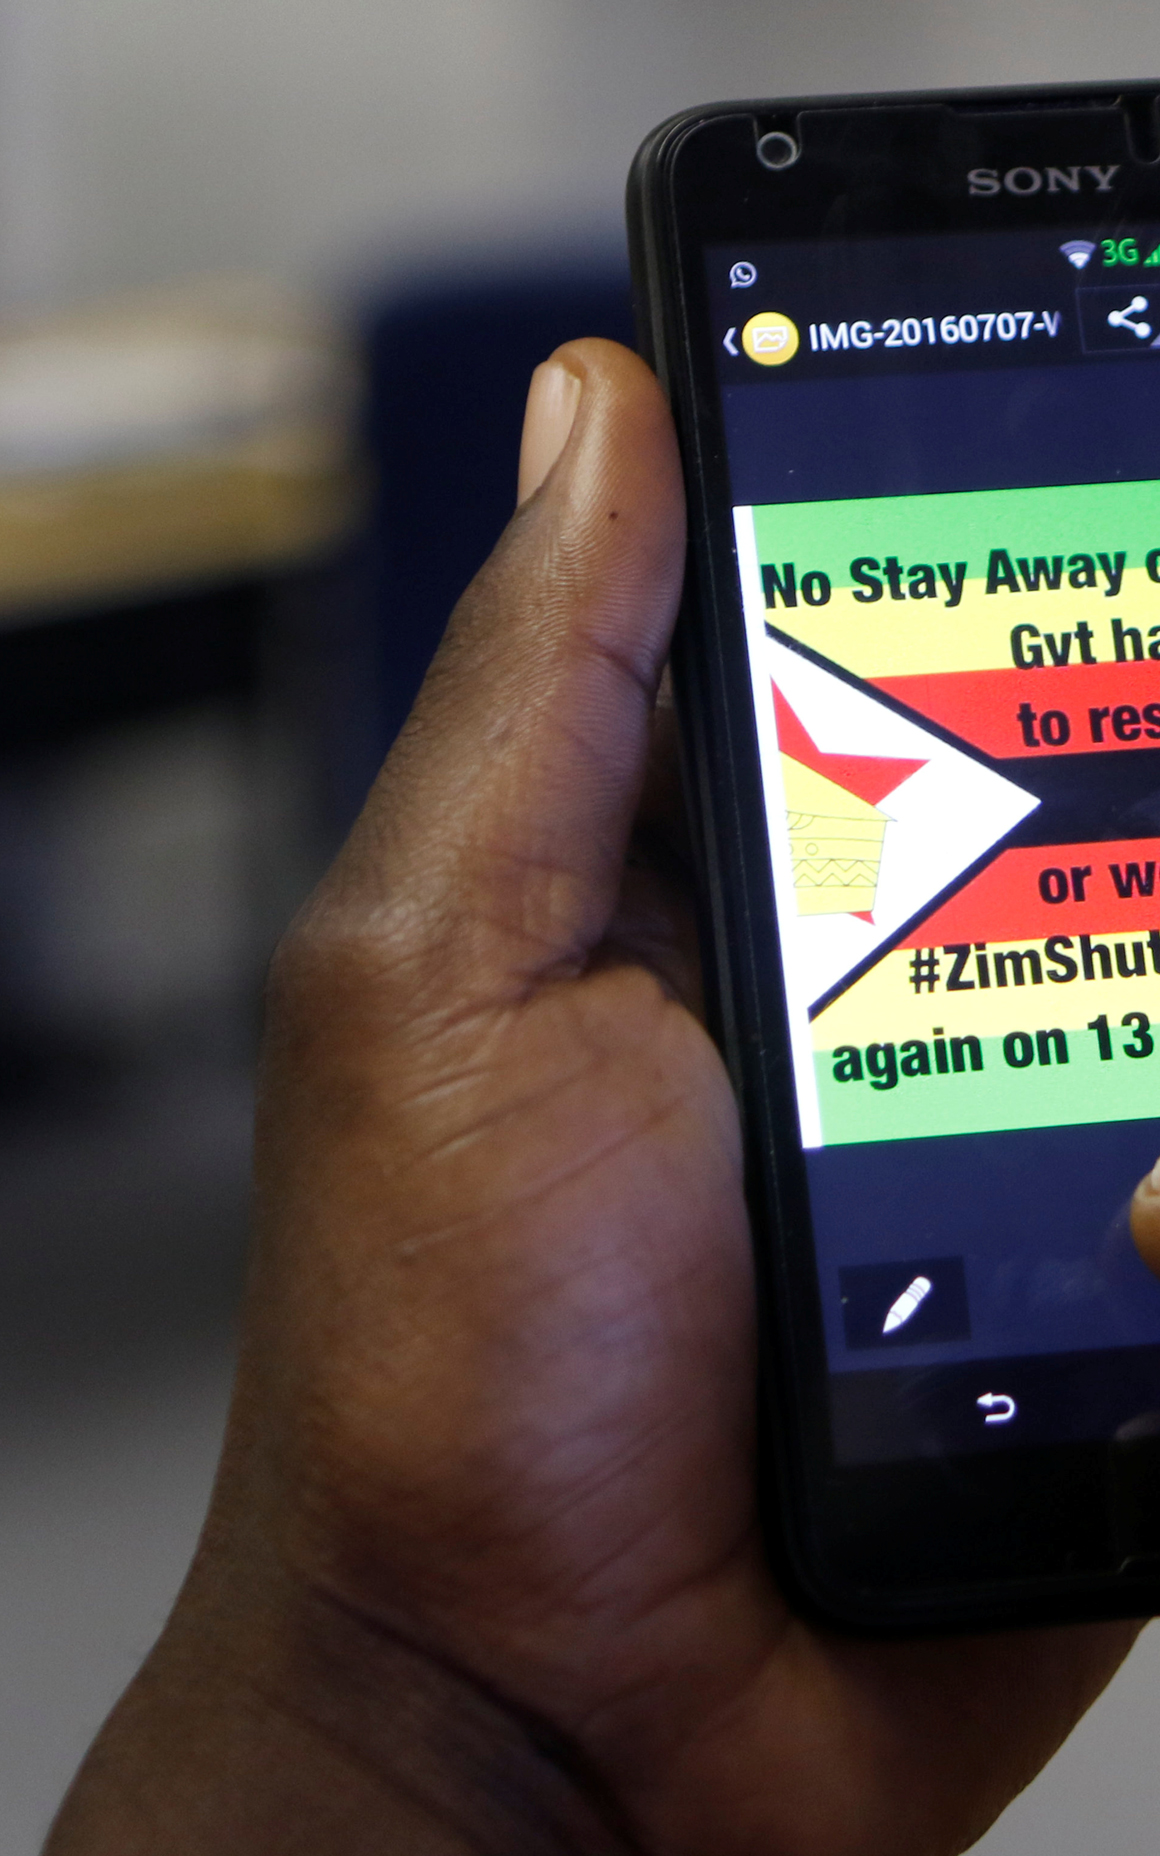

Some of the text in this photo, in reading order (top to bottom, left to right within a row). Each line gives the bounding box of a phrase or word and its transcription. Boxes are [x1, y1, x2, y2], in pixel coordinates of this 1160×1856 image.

[966, 164, 1120, 198] SONY
[1101, 238, 1139, 268] 3G
[761, 563, 831, 609] No
[852, 556, 966, 608] Stay
[986, 548, 1127, 597] Away
[1011, 621, 1097, 670] Gvt
[1017, 703, 1070, 748] to
[1037, 864, 1091, 904] or
[832, 1028, 983, 1090] again
[1004, 1025, 1068, 1067] on
[1087, 1012, 1154, 1060] 13
